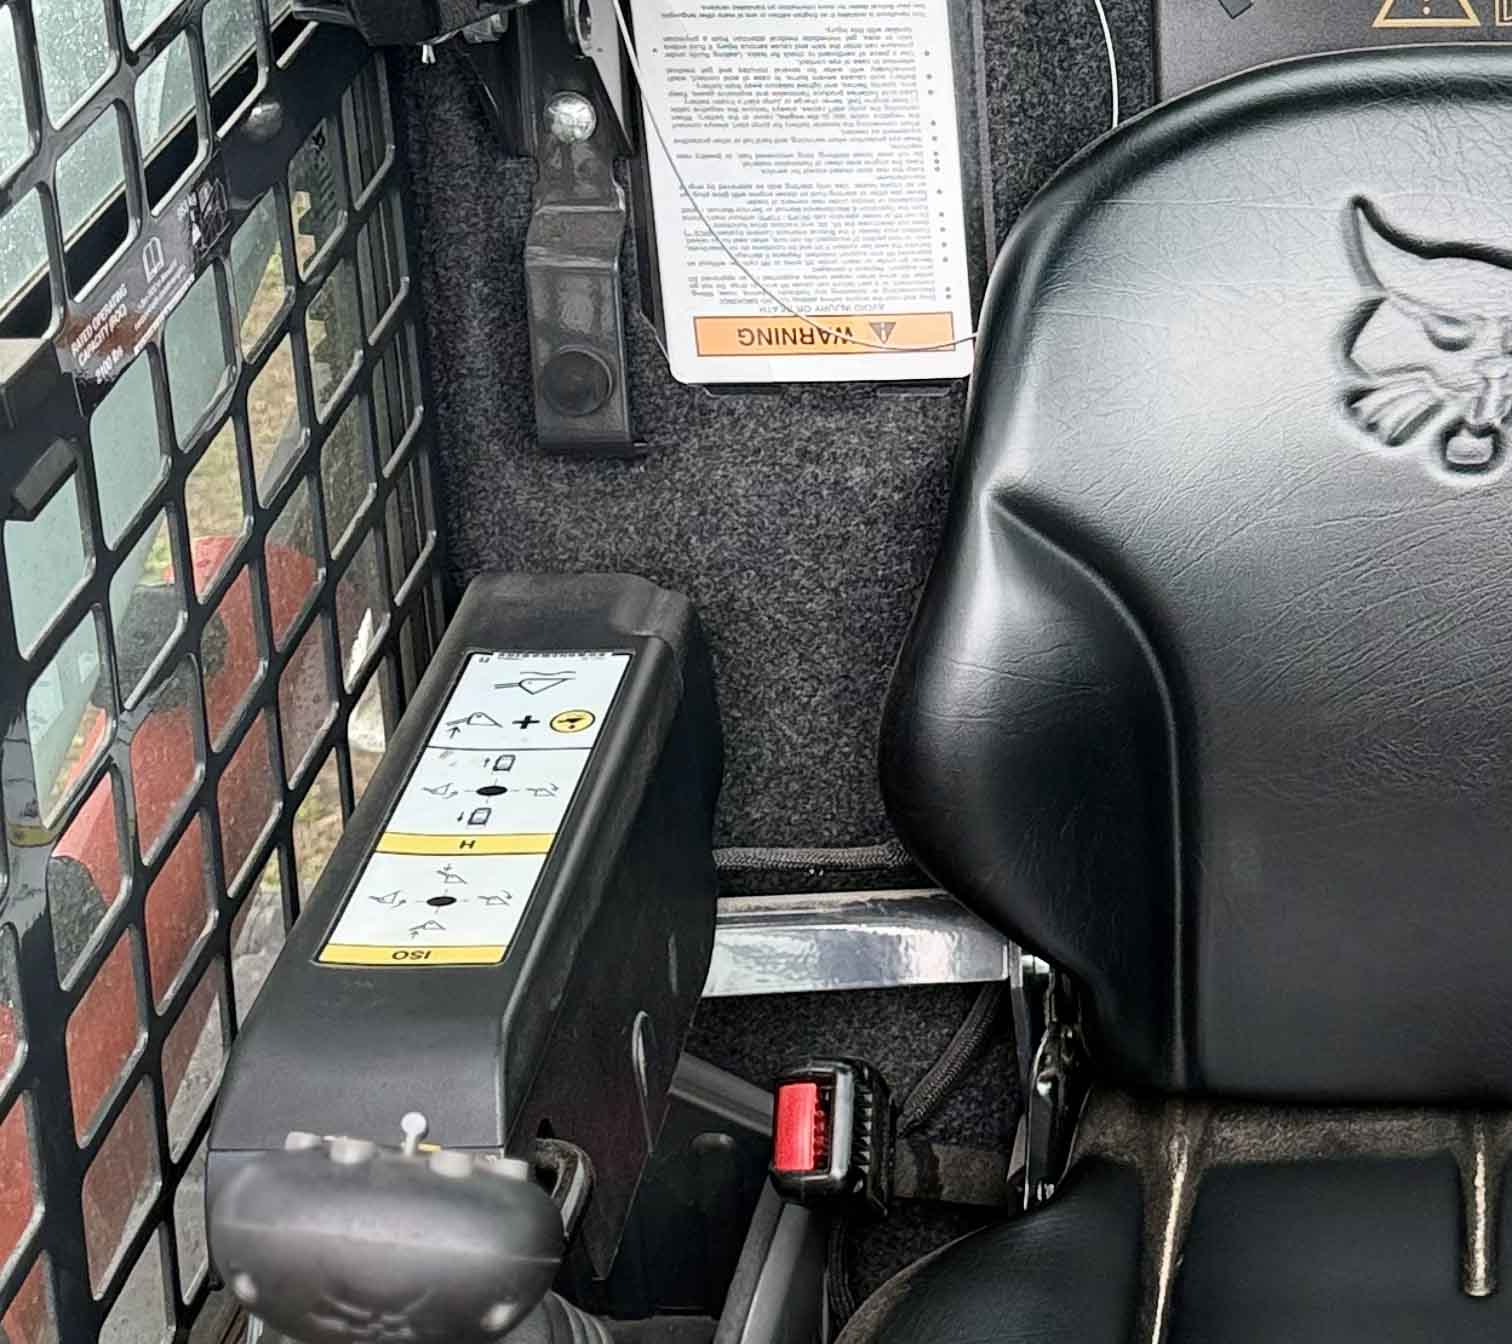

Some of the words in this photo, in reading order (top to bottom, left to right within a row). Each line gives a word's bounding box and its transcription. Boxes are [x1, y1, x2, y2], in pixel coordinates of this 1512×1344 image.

[737, 327, 853, 345] WARNING
[459, 838, 476, 849] H
[391, 949, 431, 960] ISO
